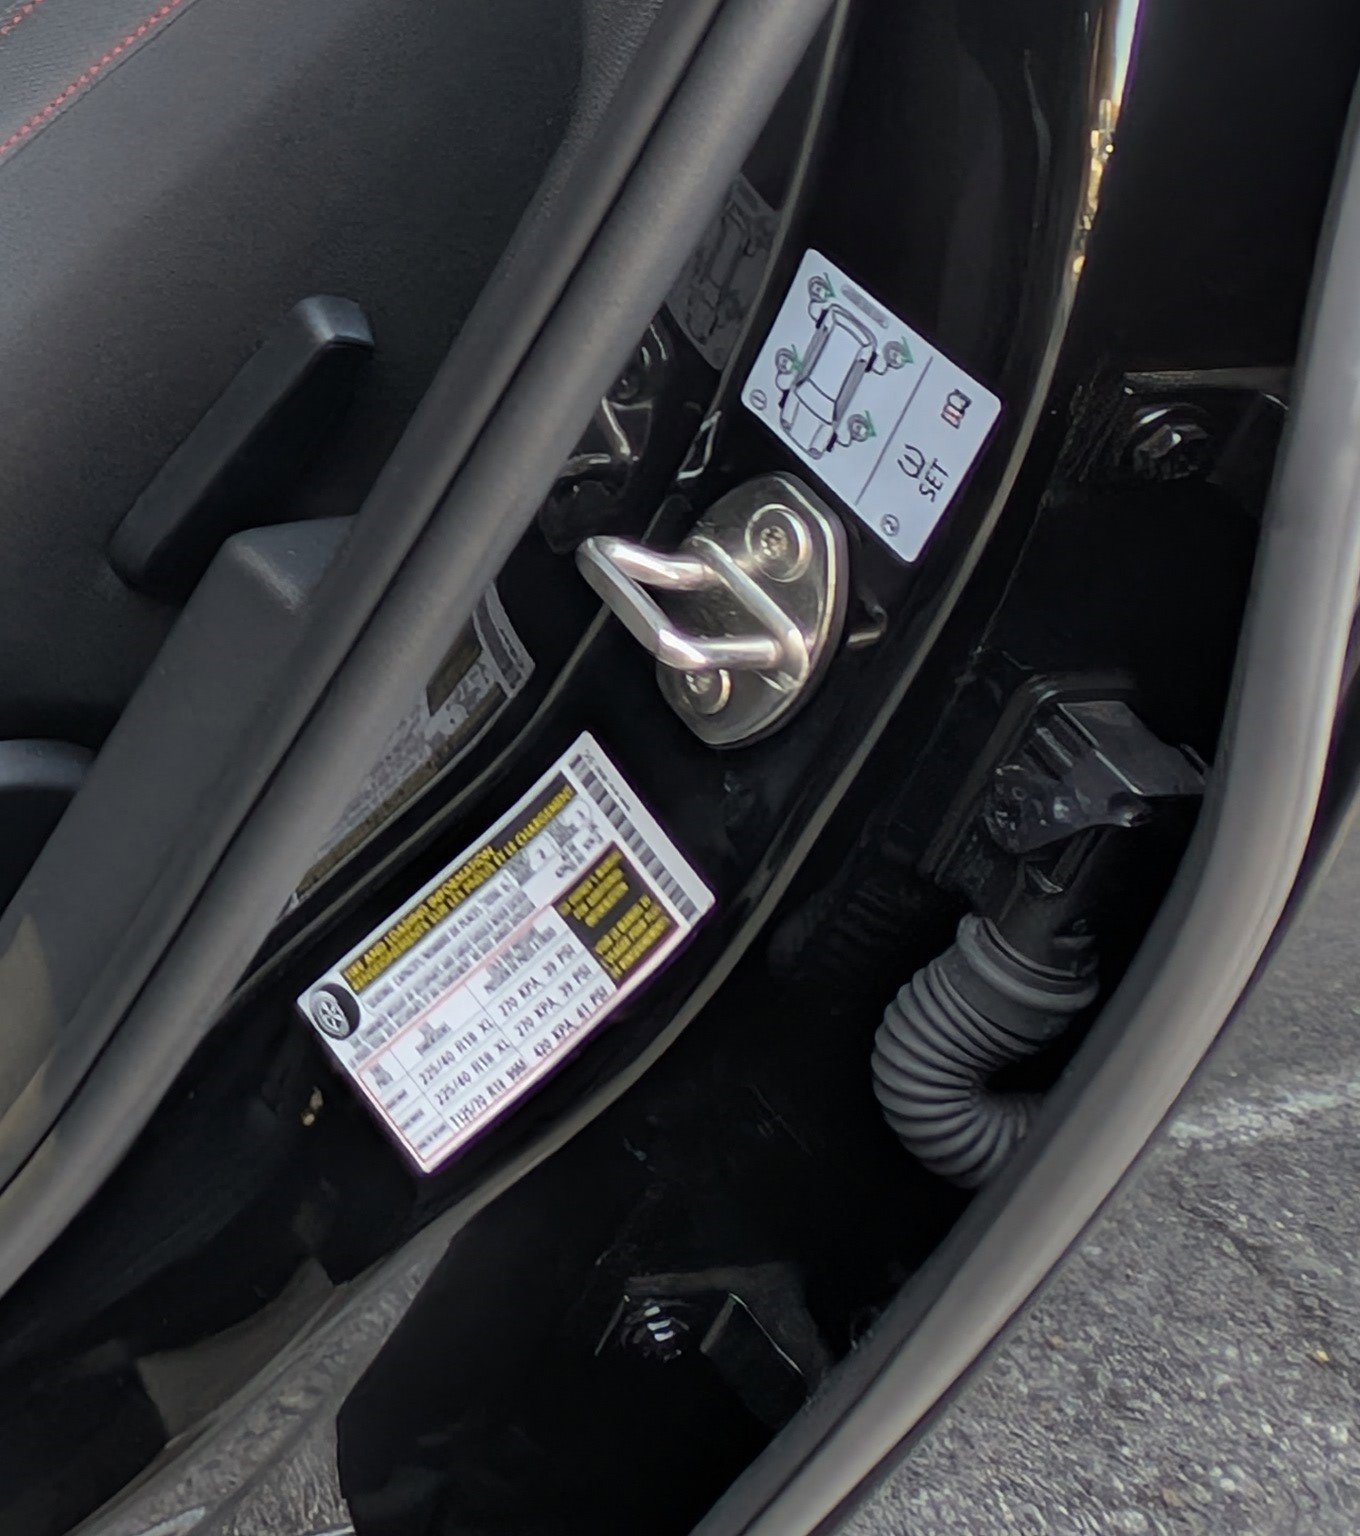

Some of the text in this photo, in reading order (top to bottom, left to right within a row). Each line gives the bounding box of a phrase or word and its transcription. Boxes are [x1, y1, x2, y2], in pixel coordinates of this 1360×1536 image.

[919, 457, 950, 503] SET
[554, 941, 577, 966] PSI
[570, 961, 593, 986] PSI
[588, 983, 609, 1006] PSI
[416, 1046, 456, 1087] 225/40
[432, 1067, 473, 1108] 225/40
